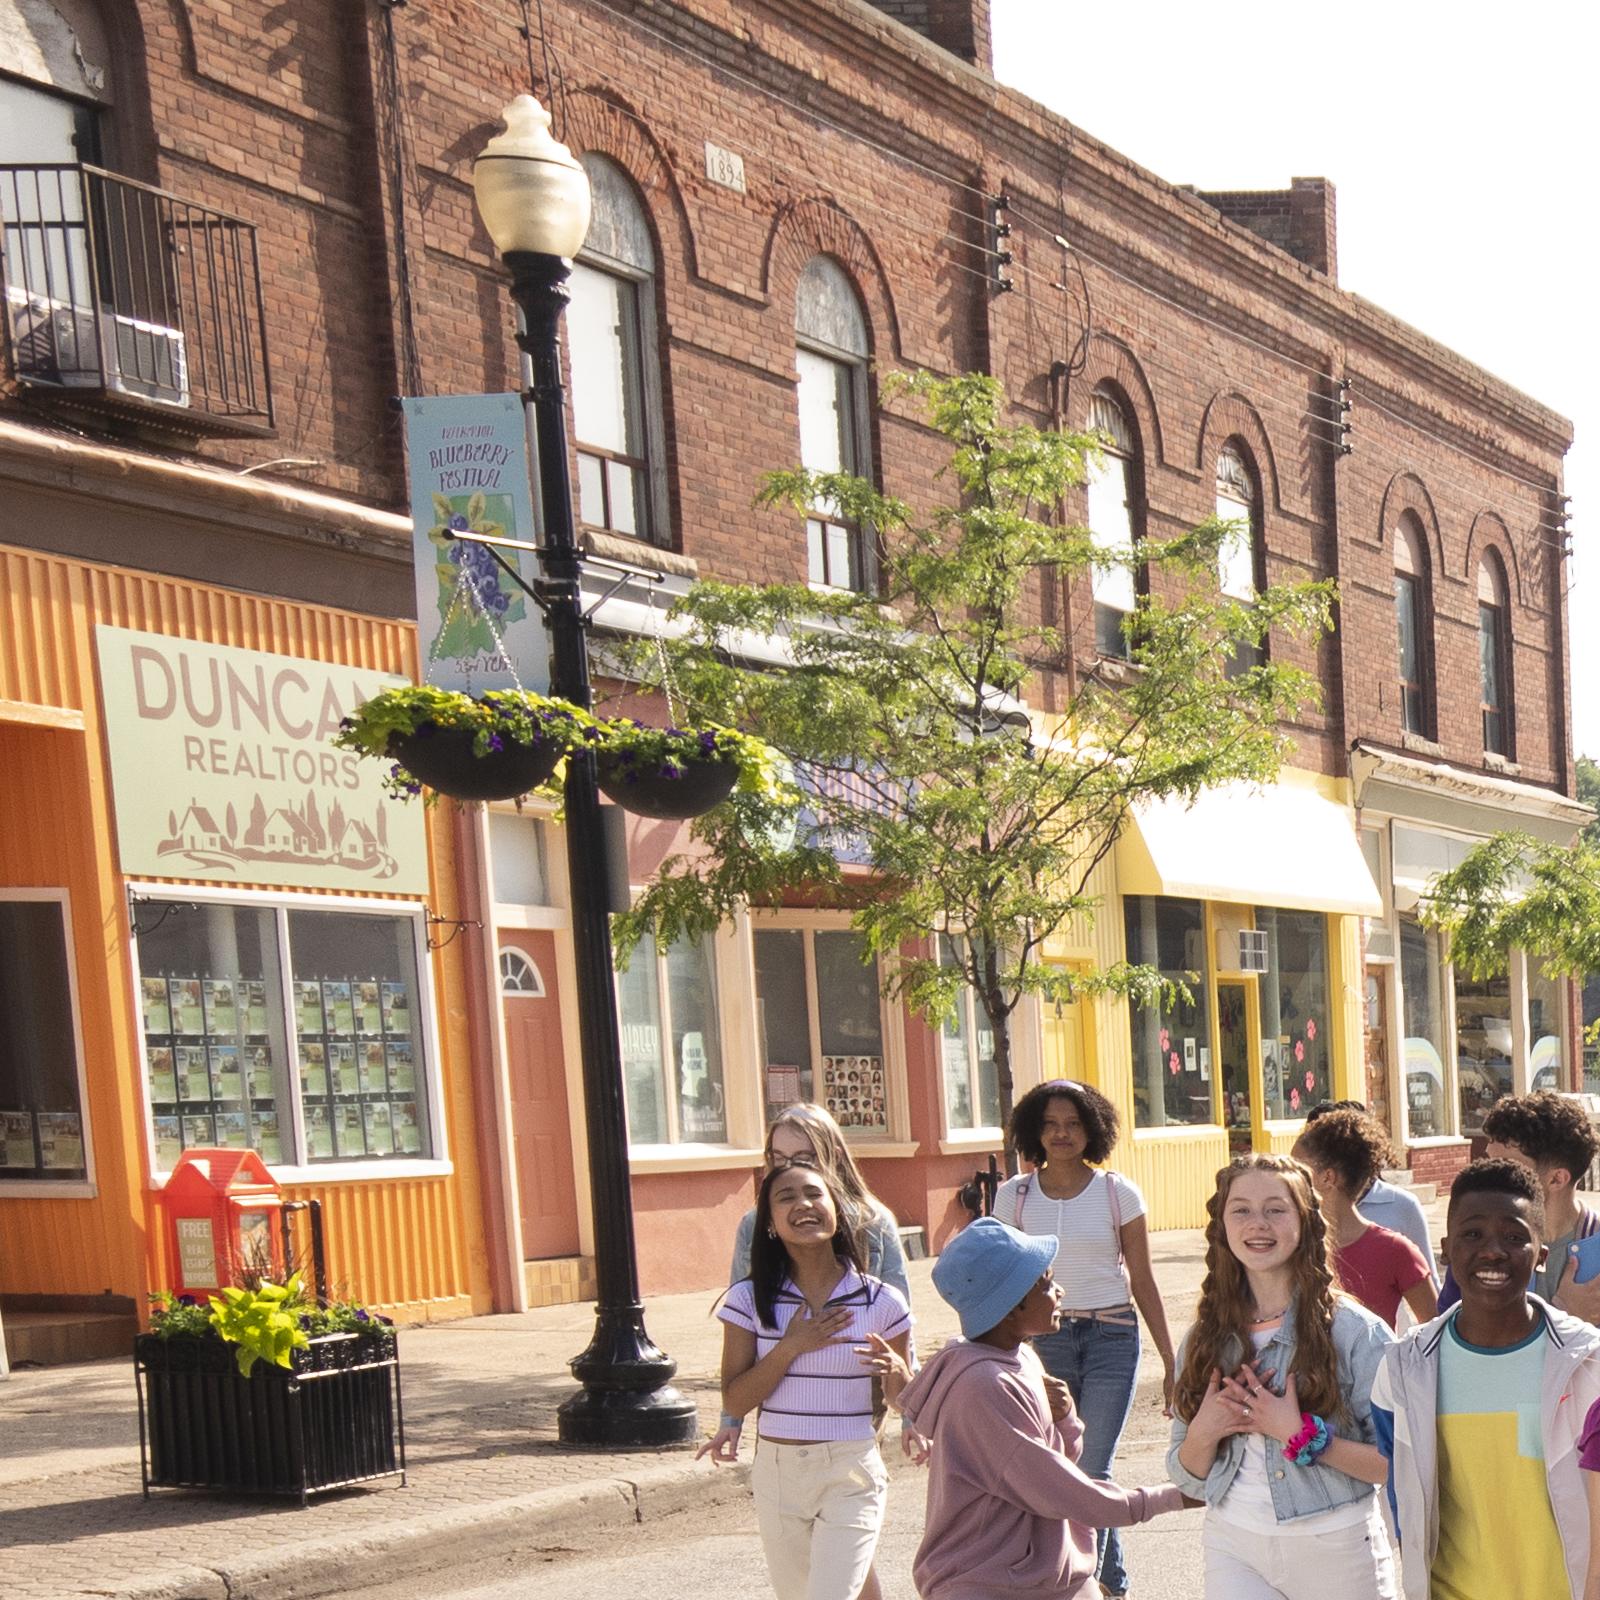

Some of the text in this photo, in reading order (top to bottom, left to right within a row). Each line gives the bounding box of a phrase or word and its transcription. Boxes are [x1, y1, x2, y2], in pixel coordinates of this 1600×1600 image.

[710, 157, 744, 190] 1894
[429, 443, 515, 470] BLUEBERRY
[440, 468, 501, 492] FESTIVAL
[184, 735, 360, 790] REALTORS
[1055, 996, 1063, 1020] 4
[182, 1222, 210, 1238] FREE
